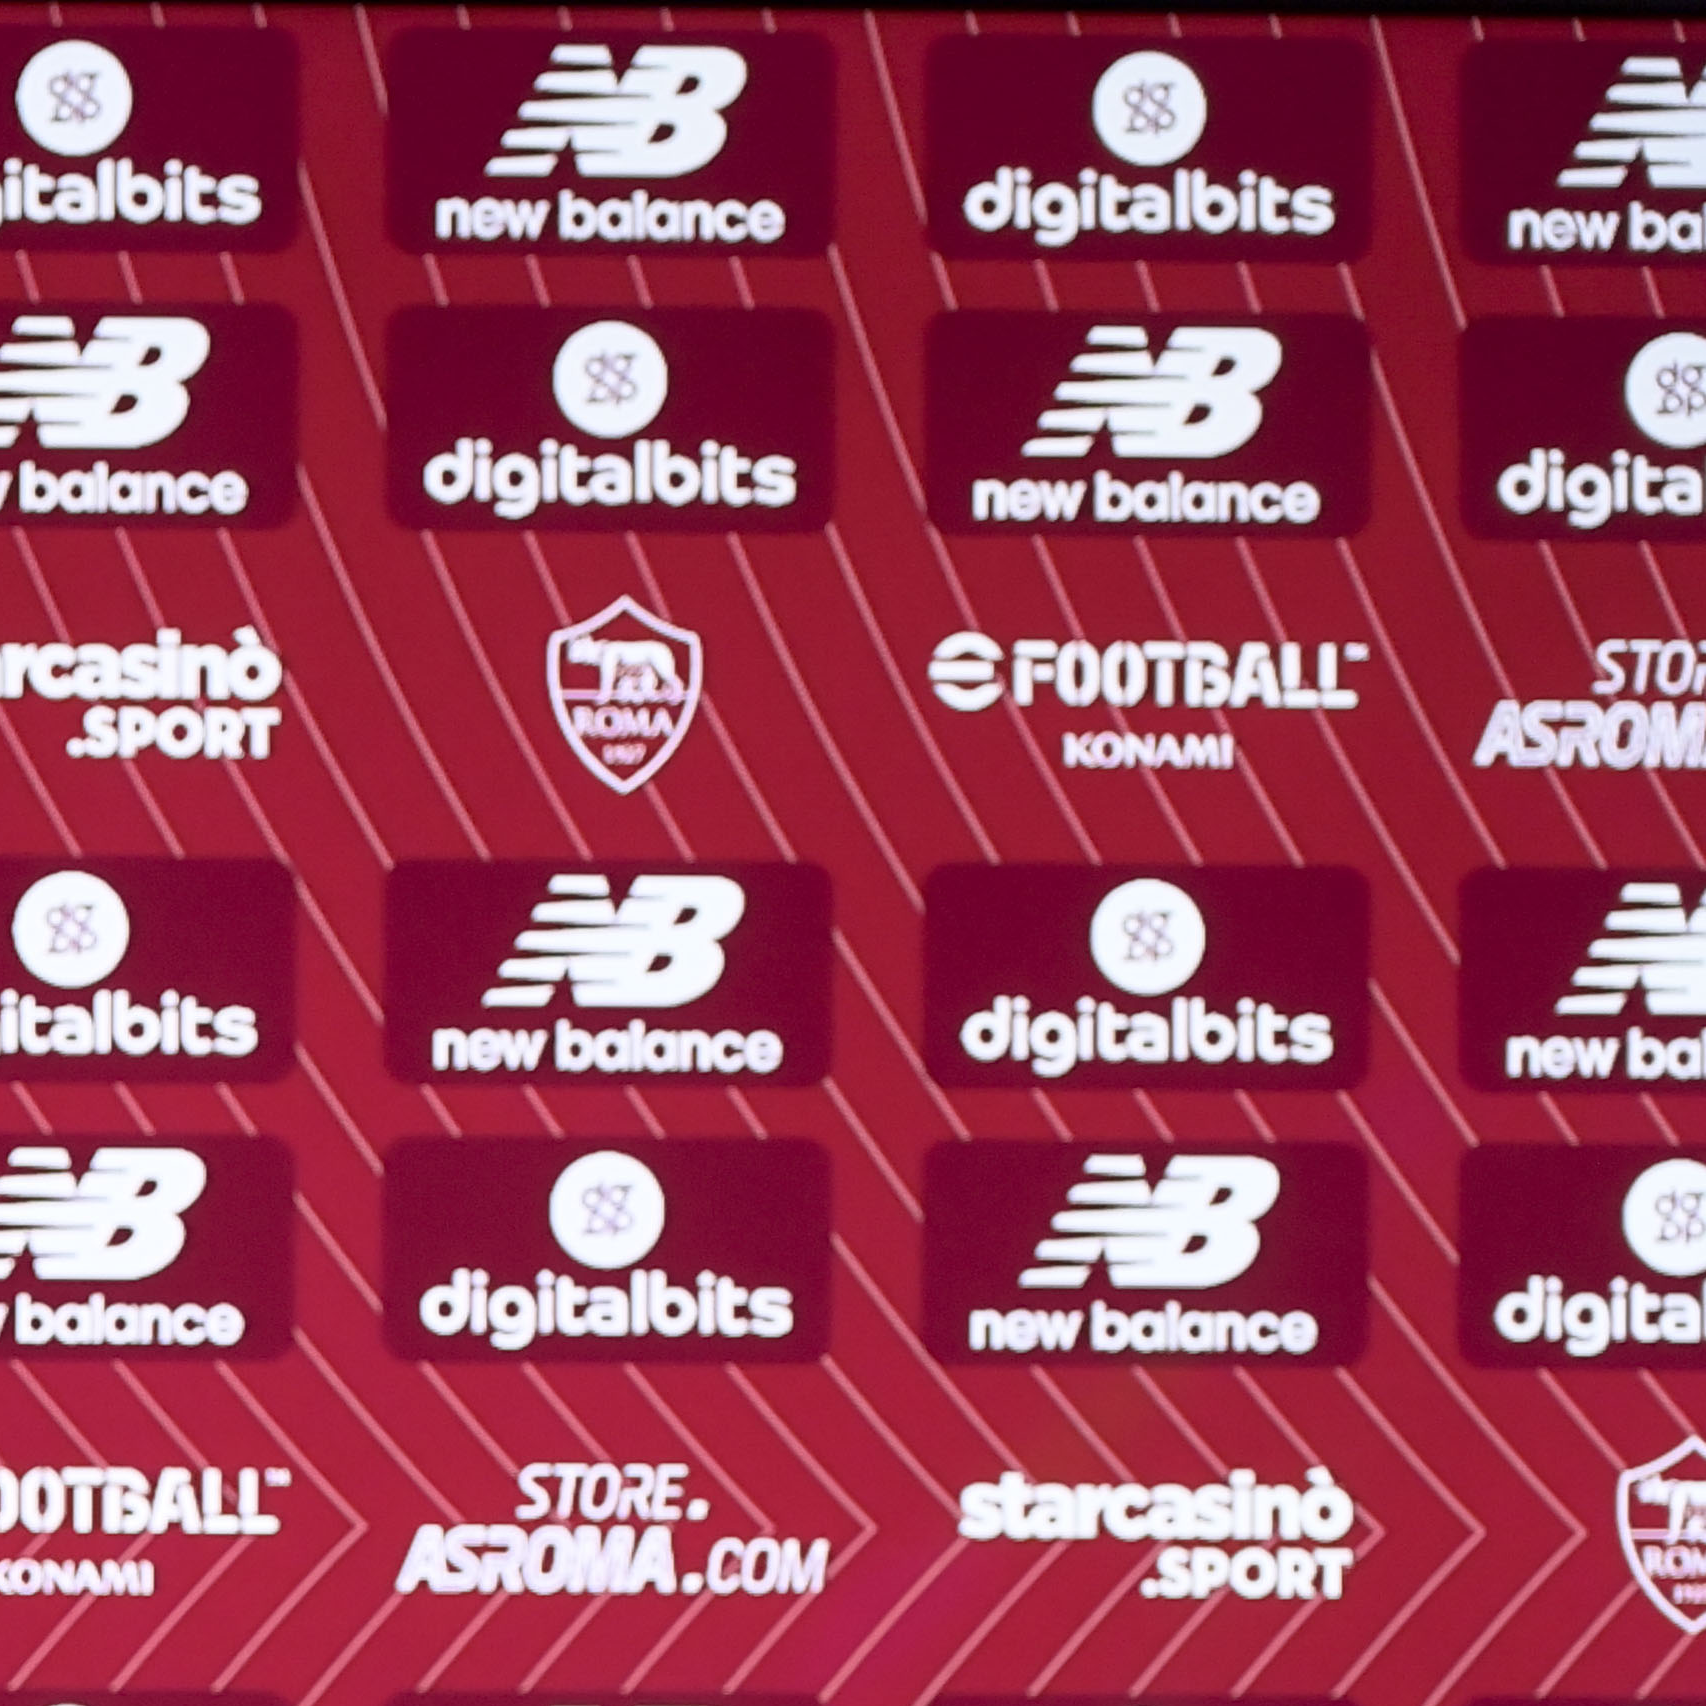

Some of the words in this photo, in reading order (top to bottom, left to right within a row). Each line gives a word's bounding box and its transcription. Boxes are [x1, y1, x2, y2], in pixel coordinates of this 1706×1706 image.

[436, 197, 550, 240] new
[559, 190, 785, 242] balance
[964, 171, 1334, 246] digitalbits
[19, 461, 248, 514] balance
[424, 441, 796, 519] digitalbits
[973, 479, 1086, 521] new
[1094, 470, 1320, 523] balance
[1063, 731, 1234, 768] KONAMI
[433, 1028, 548, 1071] new
[555, 1019, 783, 1073] balance
[960, 999, 1333, 1077] digitalbits
[15, 1293, 245, 1345] balance
[420, 1271, 793, 1350] digitalbits
[969, 1309, 1083, 1352] new
[1091, 1300, 1318, 1354] balance
[958, 1465, 1354, 1541] starcasinò
[395, 1526, 830, 1595] ASROMA.COM
